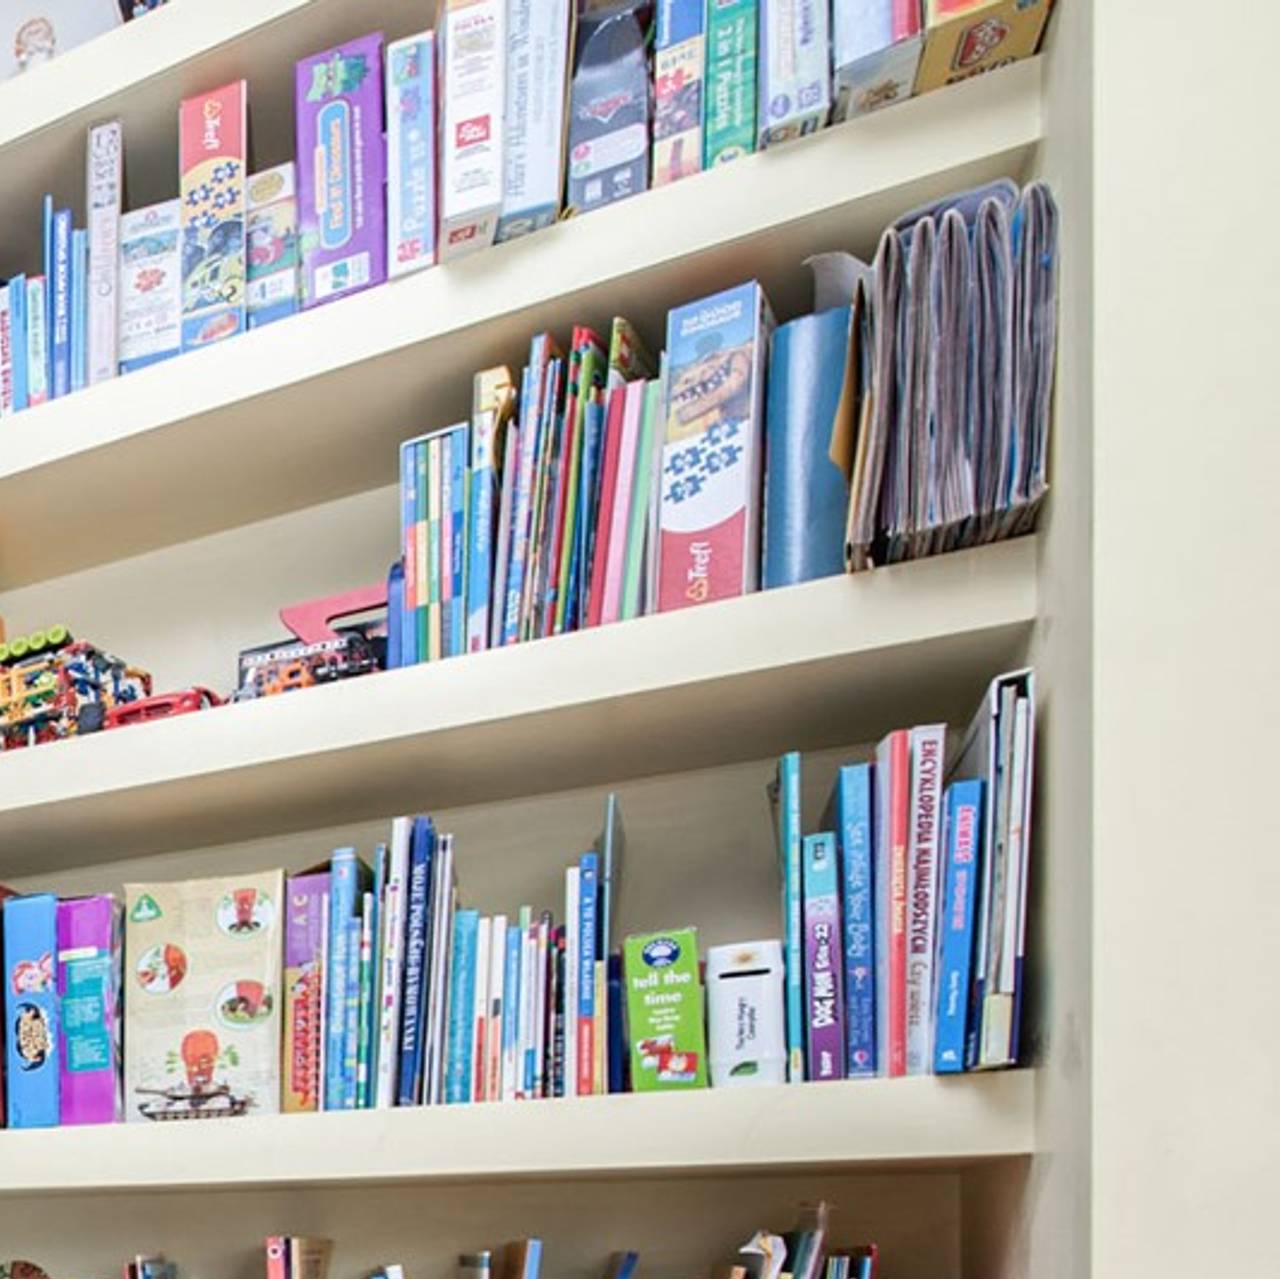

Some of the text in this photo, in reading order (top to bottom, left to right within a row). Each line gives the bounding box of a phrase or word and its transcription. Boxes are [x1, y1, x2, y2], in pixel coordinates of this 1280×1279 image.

[204, 112, 218, 151] Trefl
[687, 540, 709, 582] Trefl
[918, 739, 938, 844] ENCYKLOPEDIA
[632, 968, 692, 990] tell the
[643, 991, 683, 1007] time
